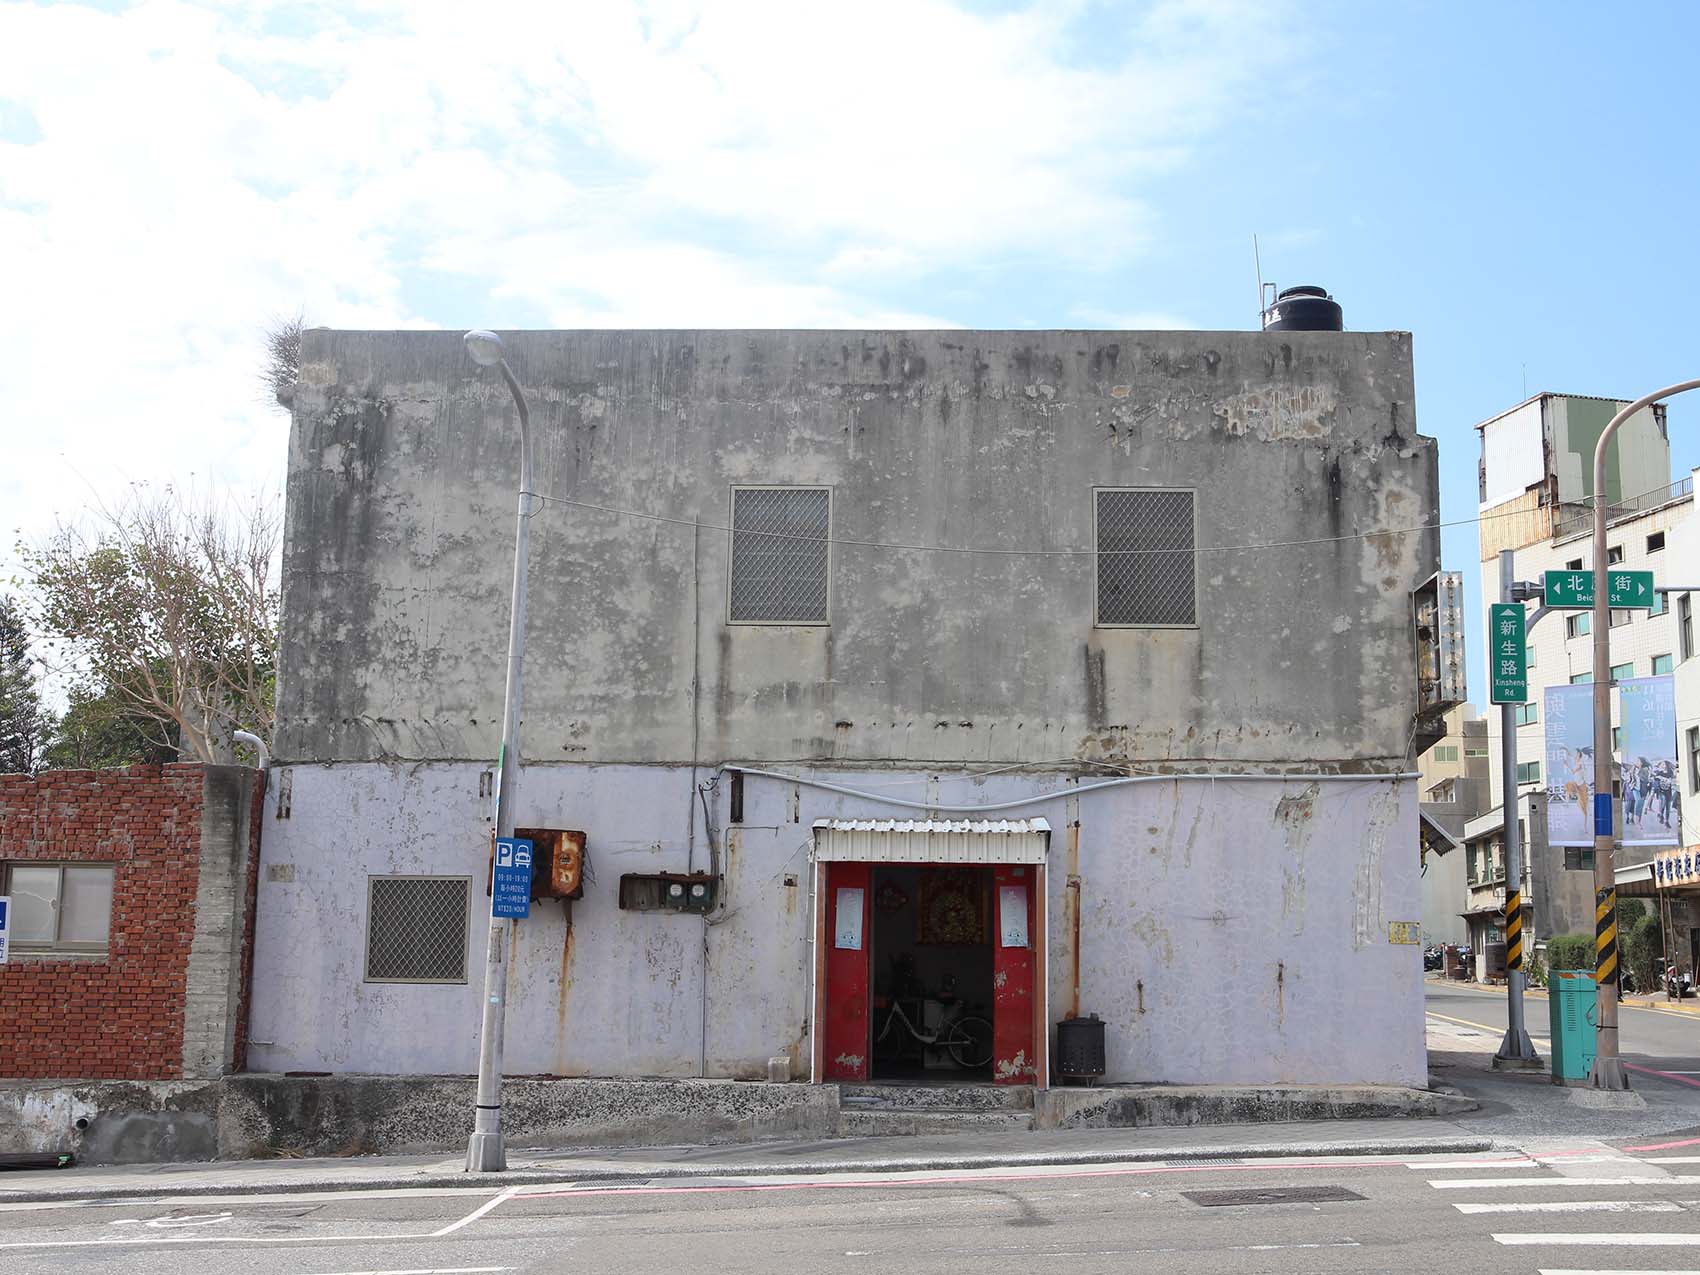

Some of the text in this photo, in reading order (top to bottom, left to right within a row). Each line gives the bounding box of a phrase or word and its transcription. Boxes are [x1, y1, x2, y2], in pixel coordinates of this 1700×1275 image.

[1567, 575, 1632, 591] 北街
[1500, 619, 1518, 676] 新生路
[1495, 678, 1525, 688] Xinsheng
[499, 844, 511, 864] P
